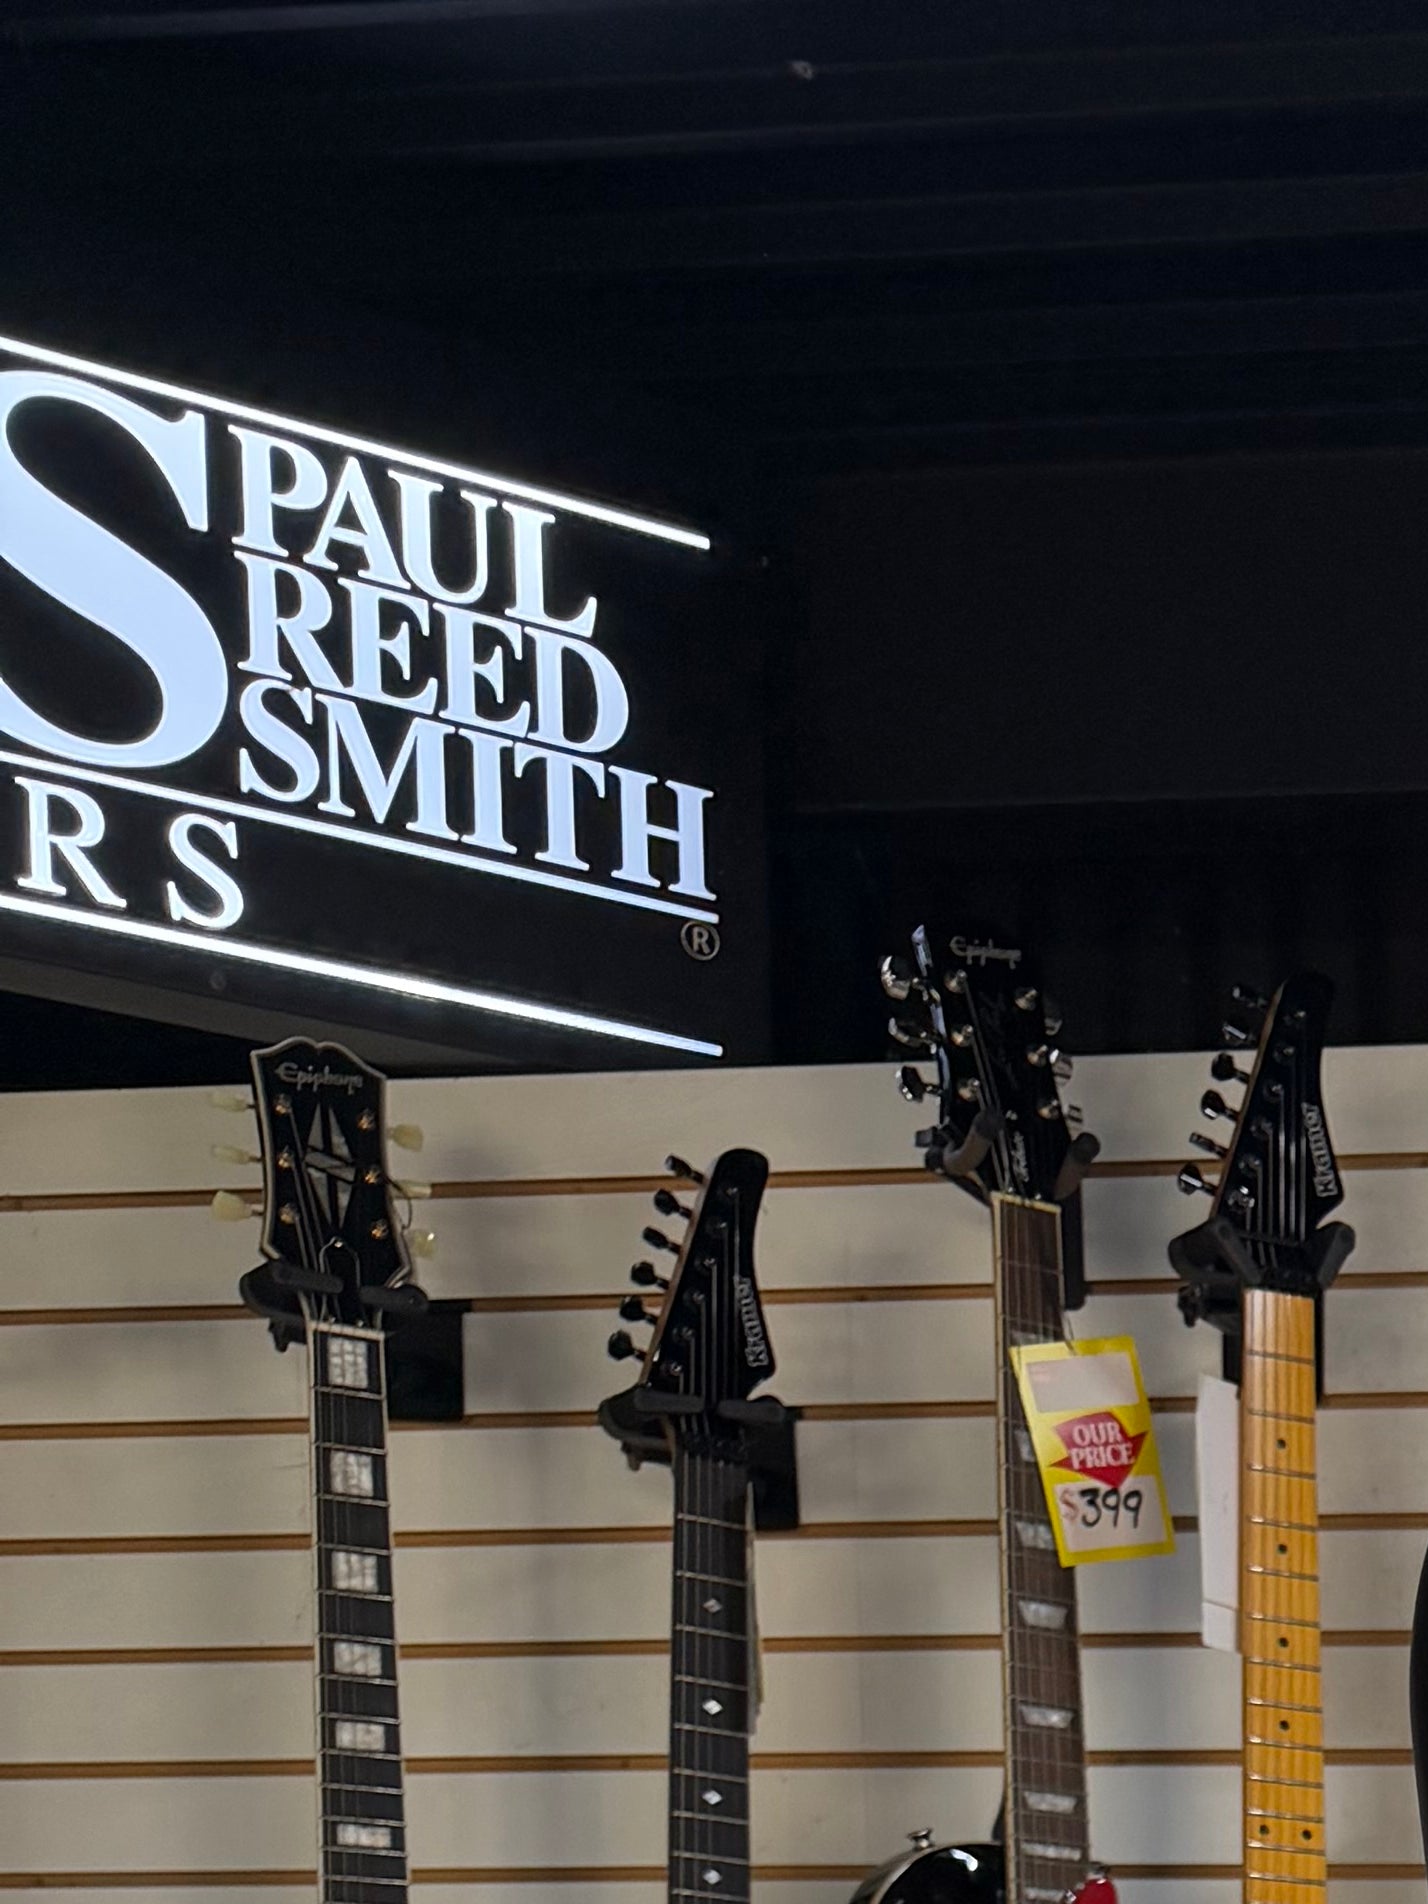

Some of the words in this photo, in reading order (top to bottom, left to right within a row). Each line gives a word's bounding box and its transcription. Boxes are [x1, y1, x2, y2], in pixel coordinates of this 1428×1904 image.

[228, 423, 598, 638] PAUL
[233, 550, 630, 755] REED
[238, 677, 717, 901] SMITH
[274, 1061, 364, 1095] Epiphone
[1071, 1421, 1124, 1446] OUR
[1069, 1442, 1136, 1470] PRICE
[1059, 1487, 1143, 1529] $399
